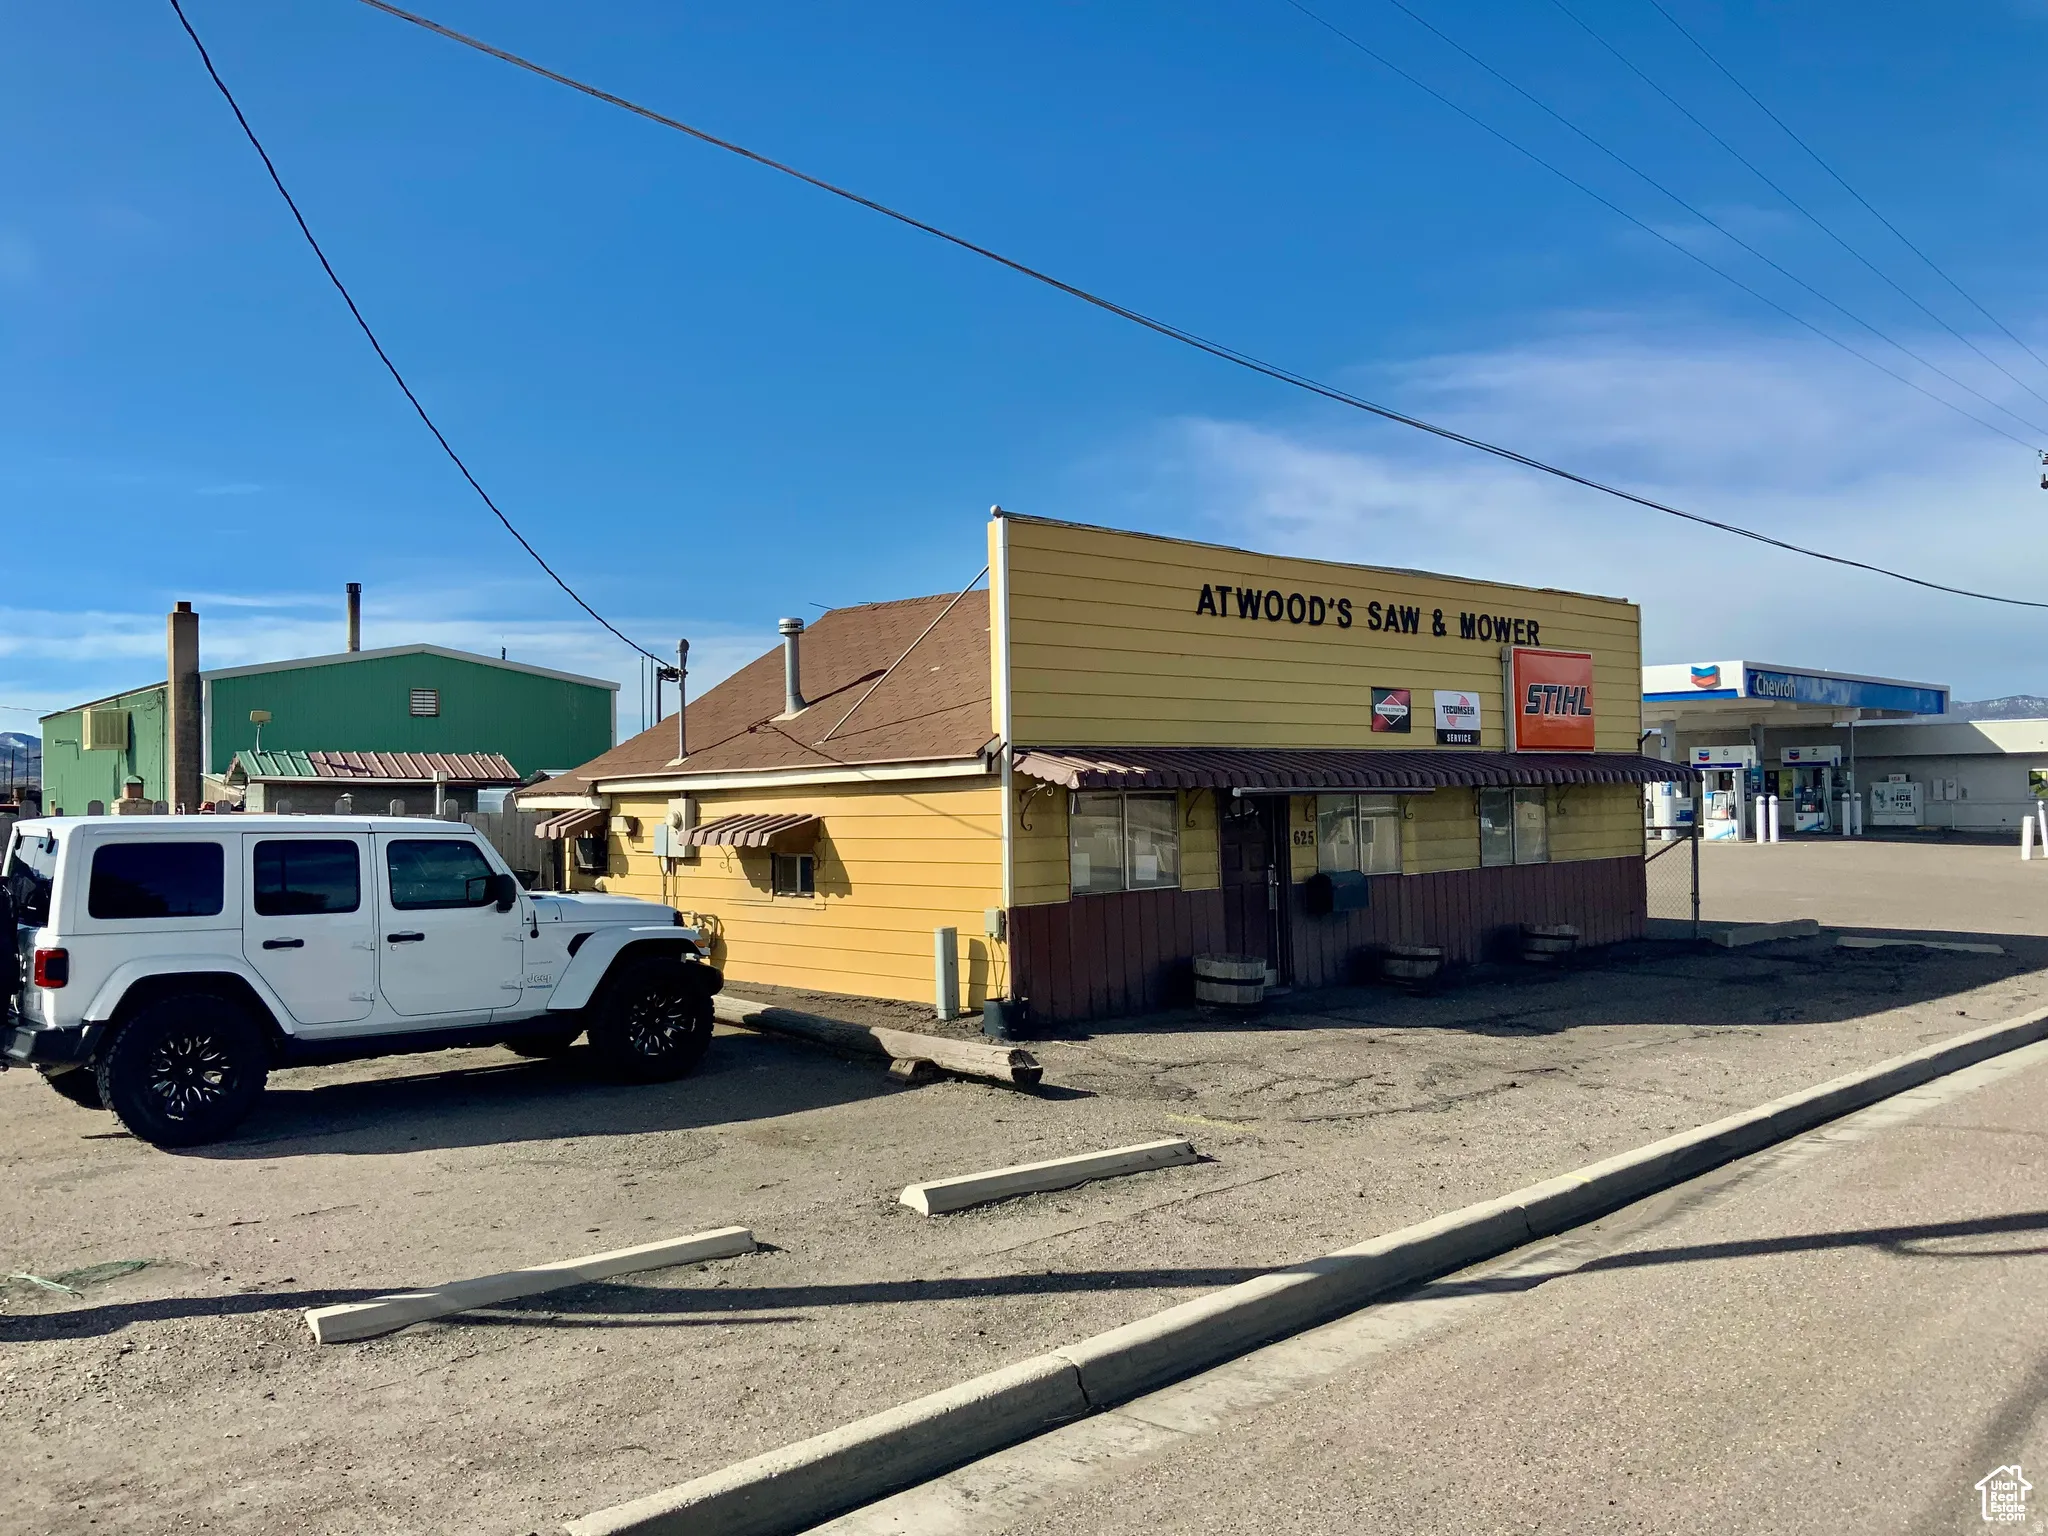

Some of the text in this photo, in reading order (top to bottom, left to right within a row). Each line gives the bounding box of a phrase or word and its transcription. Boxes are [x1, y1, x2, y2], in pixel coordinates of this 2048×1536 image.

[1196, 583, 1540, 646] ATWOOD'S SAW & MOWER
[1756, 673, 1796, 698] Chevron
[1523, 682, 1592, 717] STIHL
[1447, 733, 1471, 743] SERVICE
[1293, 829, 1314, 845] 625
[527, 972, 552, 983] Jeep
